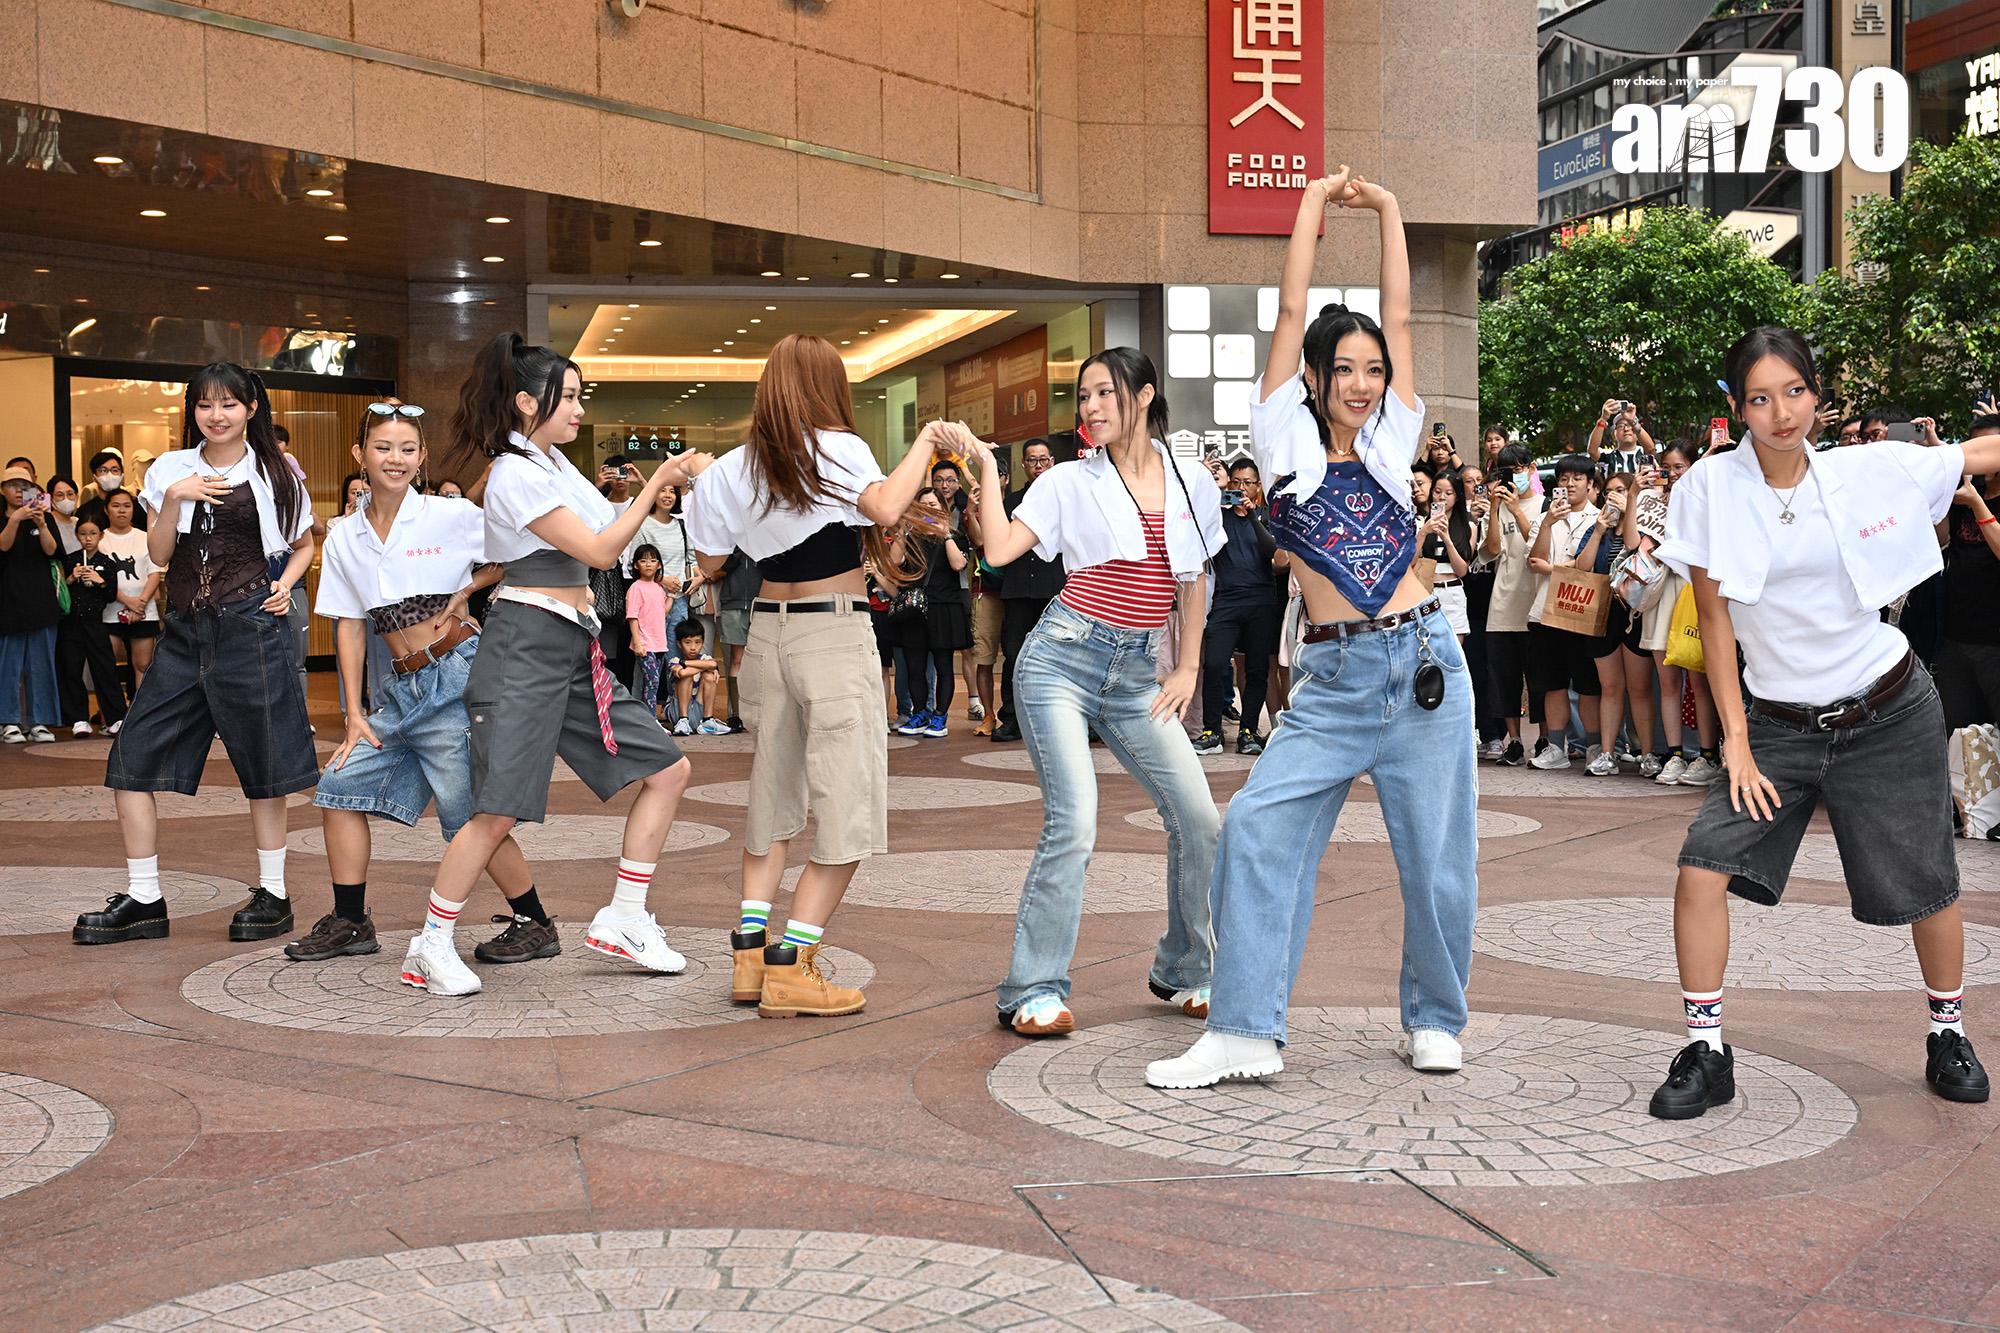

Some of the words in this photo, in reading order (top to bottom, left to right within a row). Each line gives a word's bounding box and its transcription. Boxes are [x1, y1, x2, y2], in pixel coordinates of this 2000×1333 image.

[1228, 153, 1306, 170] FOOD
[1553, 150, 1601, 180] EuroEyes
[1228, 172, 1307, 189] FORUM
[628, 441, 641, 450] B2
[650, 441, 659, 450] G
[668, 441, 681, 450] B3
[1288, 507, 1317, 526] COWBOY
[1348, 549, 1382, 559] COWBOY
[1557, 582, 1595, 605] MUJI
